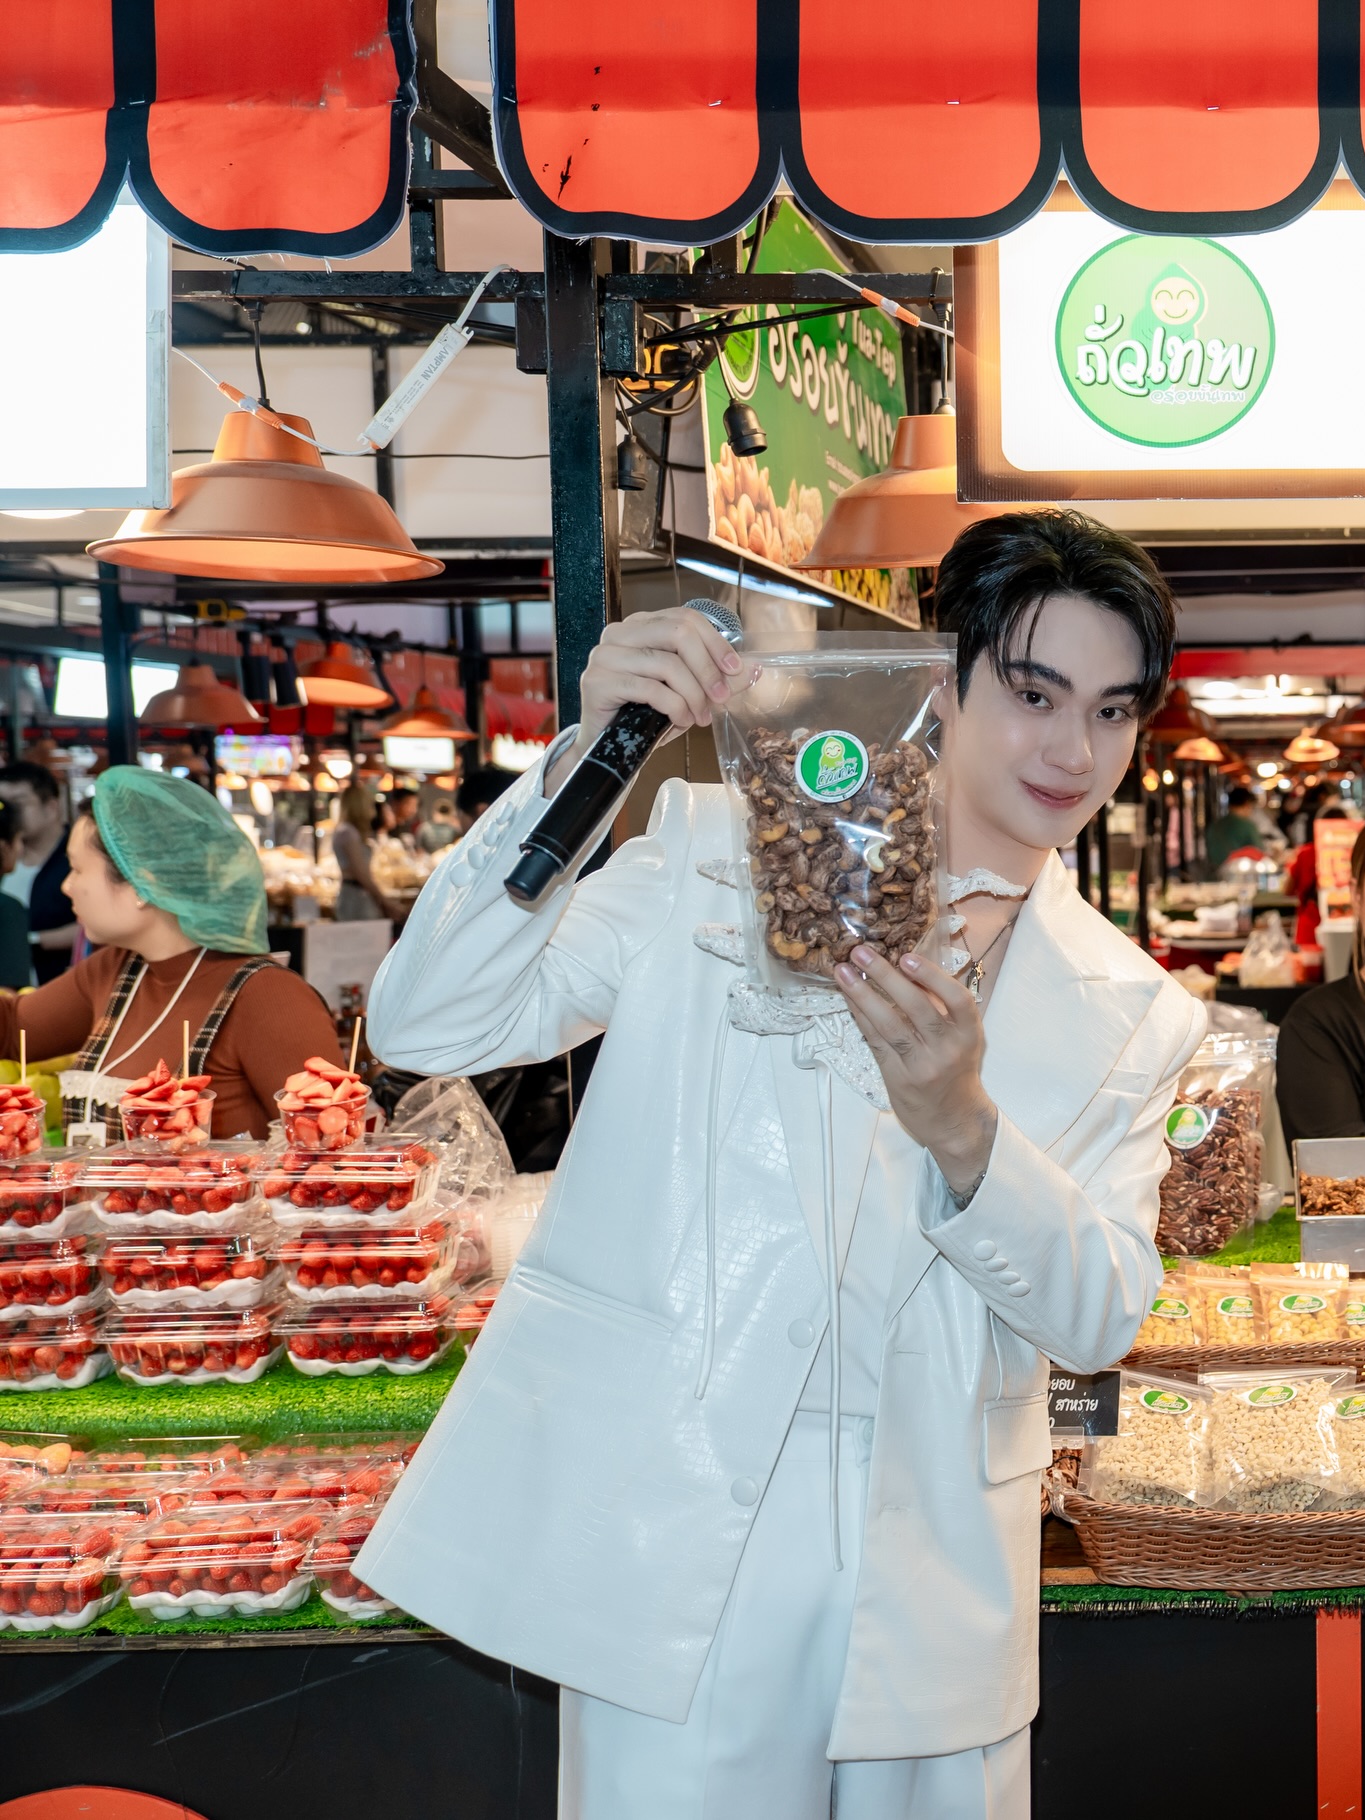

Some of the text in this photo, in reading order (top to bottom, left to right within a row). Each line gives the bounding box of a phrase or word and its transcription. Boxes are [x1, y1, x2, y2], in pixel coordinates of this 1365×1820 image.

[1075, 303, 1257, 397] ถั่วเทพ
[1050, 1378, 1076, 1391] ยอบ
[1055, 1391, 1099, 1411] สาหร่าย
